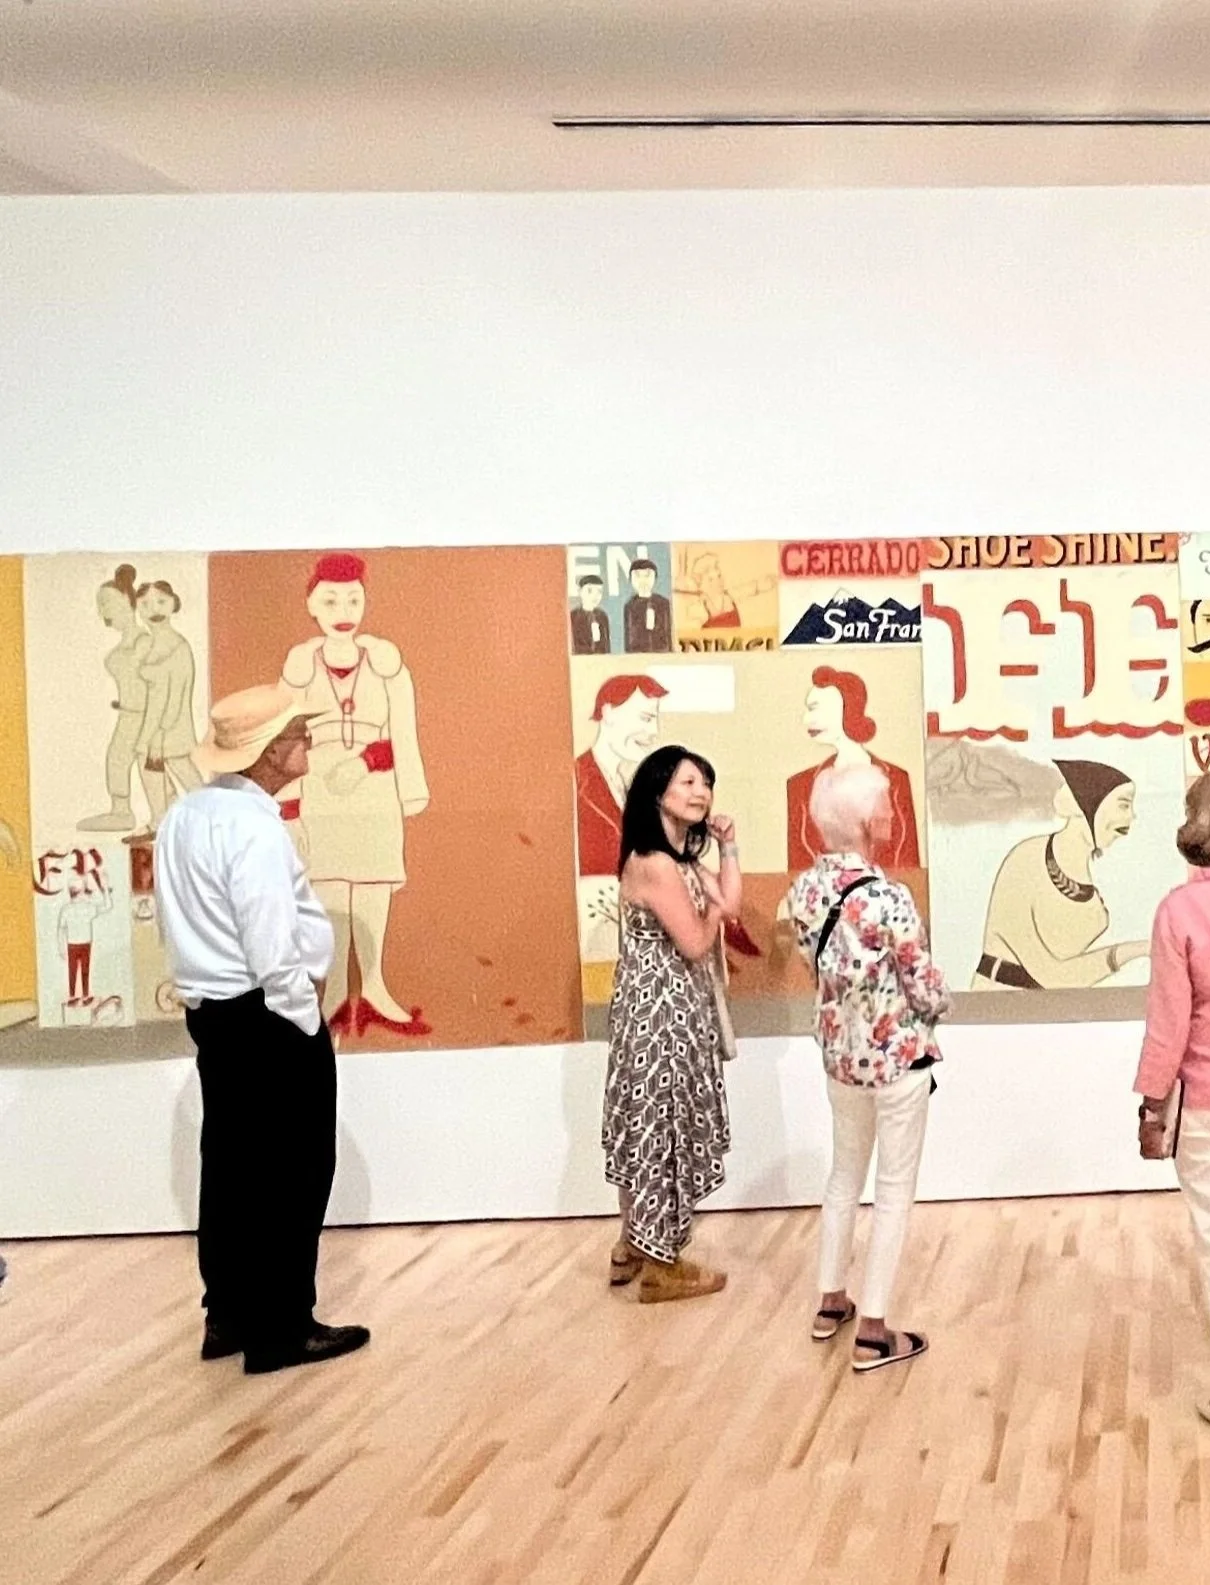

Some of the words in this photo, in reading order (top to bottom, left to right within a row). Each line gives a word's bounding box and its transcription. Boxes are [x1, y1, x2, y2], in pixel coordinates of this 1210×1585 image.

[781, 541, 920, 576] CERRADO
[926, 536, 1031, 569] SHOE
[816, 608, 869, 643] San
